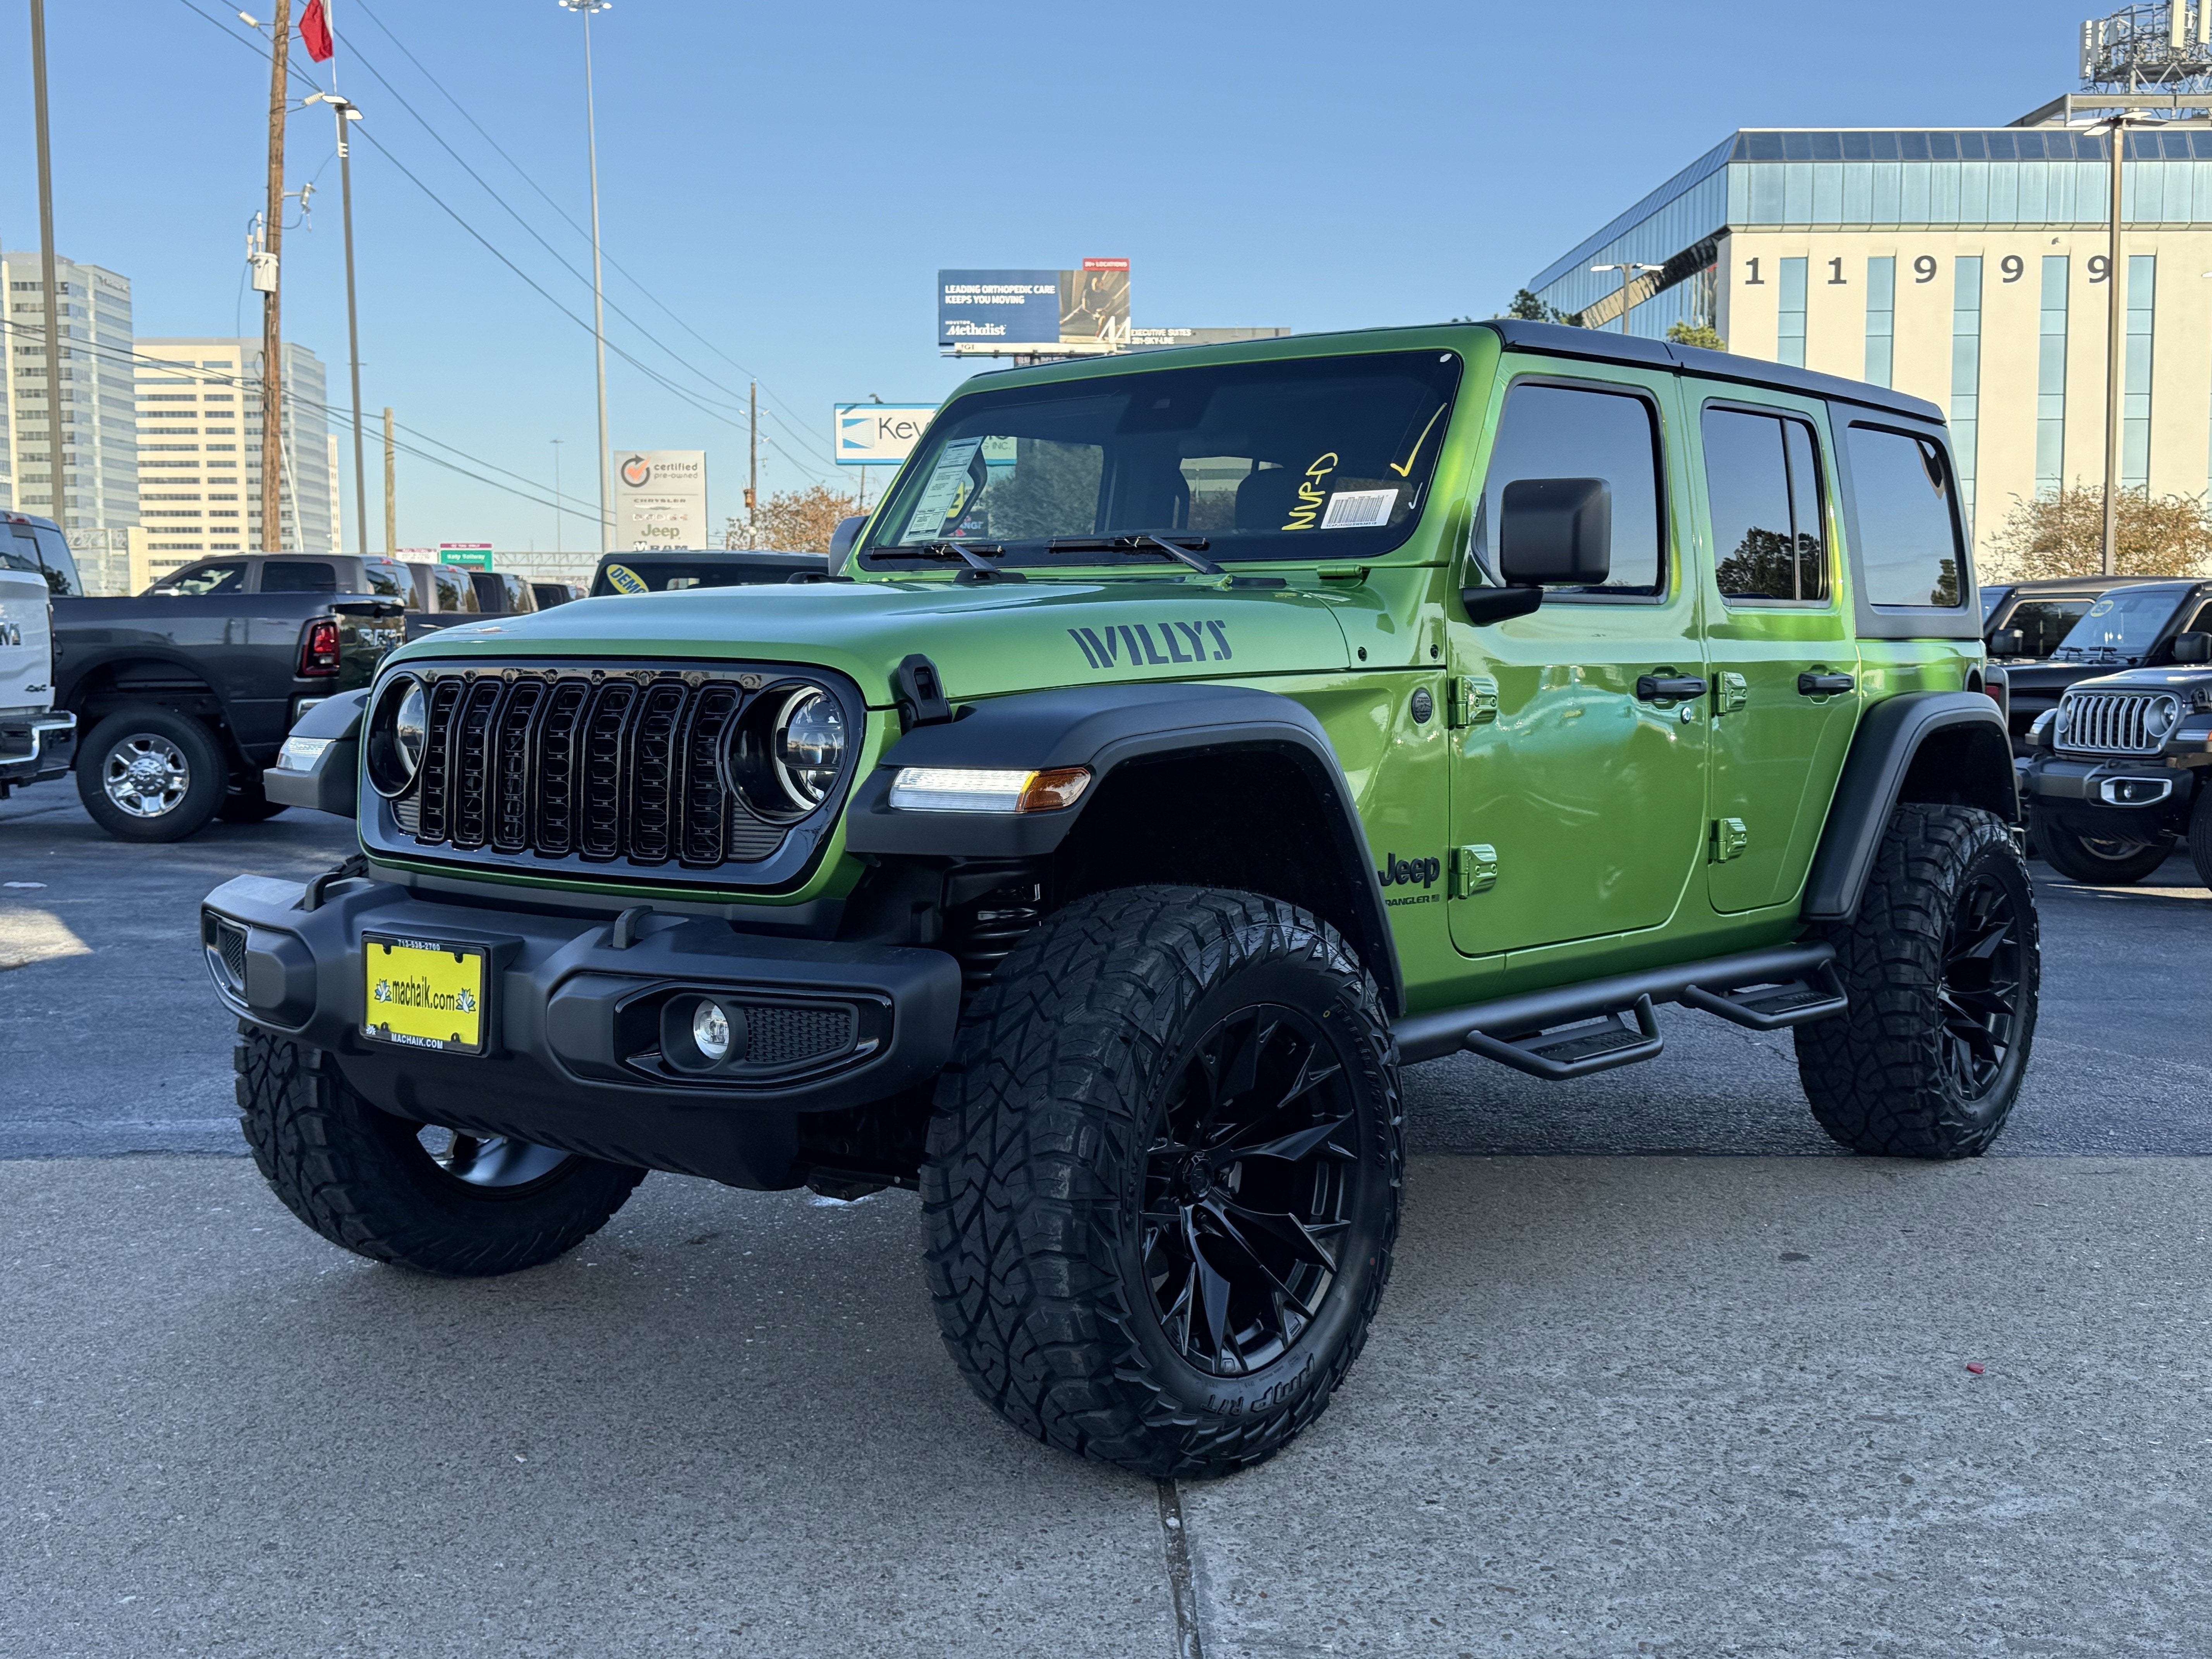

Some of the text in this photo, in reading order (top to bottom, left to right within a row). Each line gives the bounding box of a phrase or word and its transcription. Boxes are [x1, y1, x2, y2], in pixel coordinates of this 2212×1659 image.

[945, 285, 1055, 294] LEADING ORTHOPEDIC CARE
[945, 295, 1025, 304] KEEPS YOU MOVING
[945, 323, 1006, 336] Methodist
[654, 462, 698, 471] certified
[641, 524, 680, 540] Jeep
[1067, 620, 1232, 669] WILLYS
[1377, 852, 1440, 889] Jeep
[1385, 895, 1430, 907] RANGLER
[392, 975, 455, 1011] machaik.com
[391, 1033, 443, 1049] MACHAIK.COM
